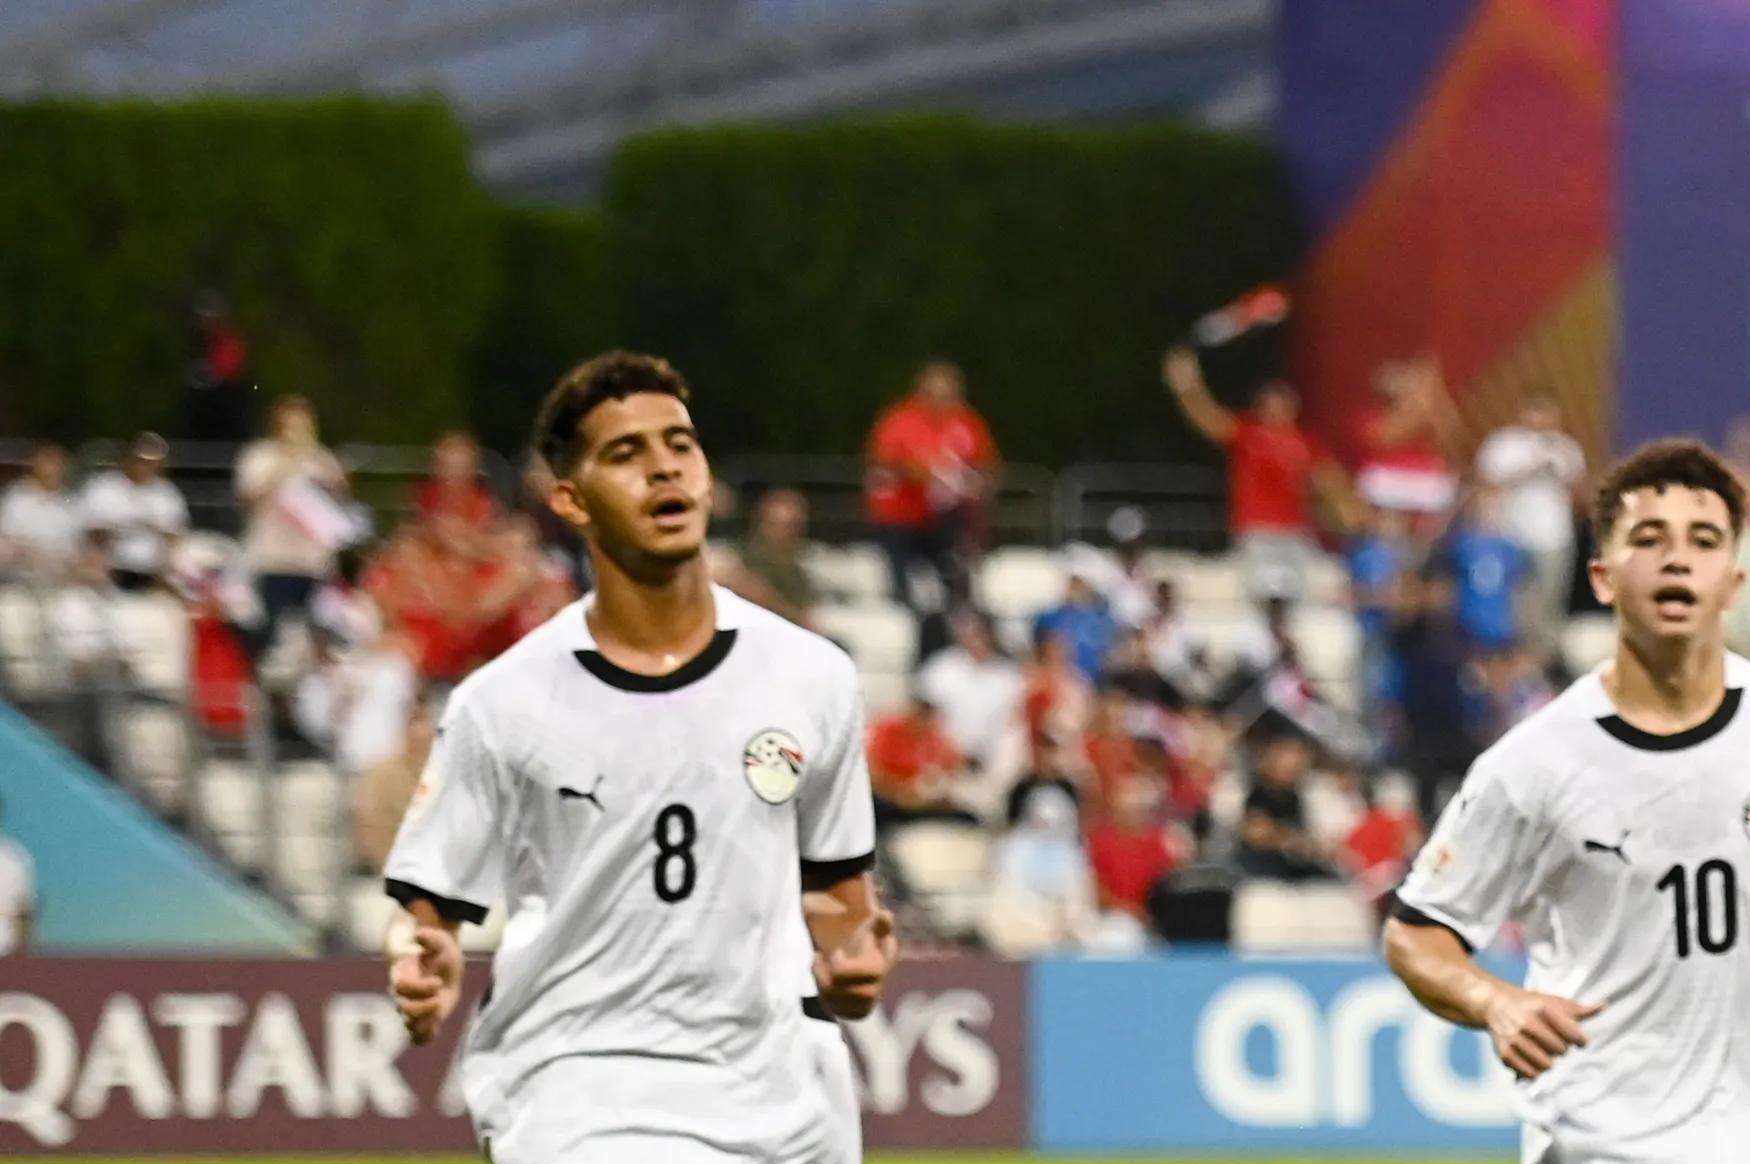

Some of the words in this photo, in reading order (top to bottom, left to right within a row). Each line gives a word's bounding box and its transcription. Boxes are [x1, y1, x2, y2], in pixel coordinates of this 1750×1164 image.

[653, 803, 698, 904] 8
[1656, 857, 1739, 959] 10
[0, 990, 416, 1147] QATAR
